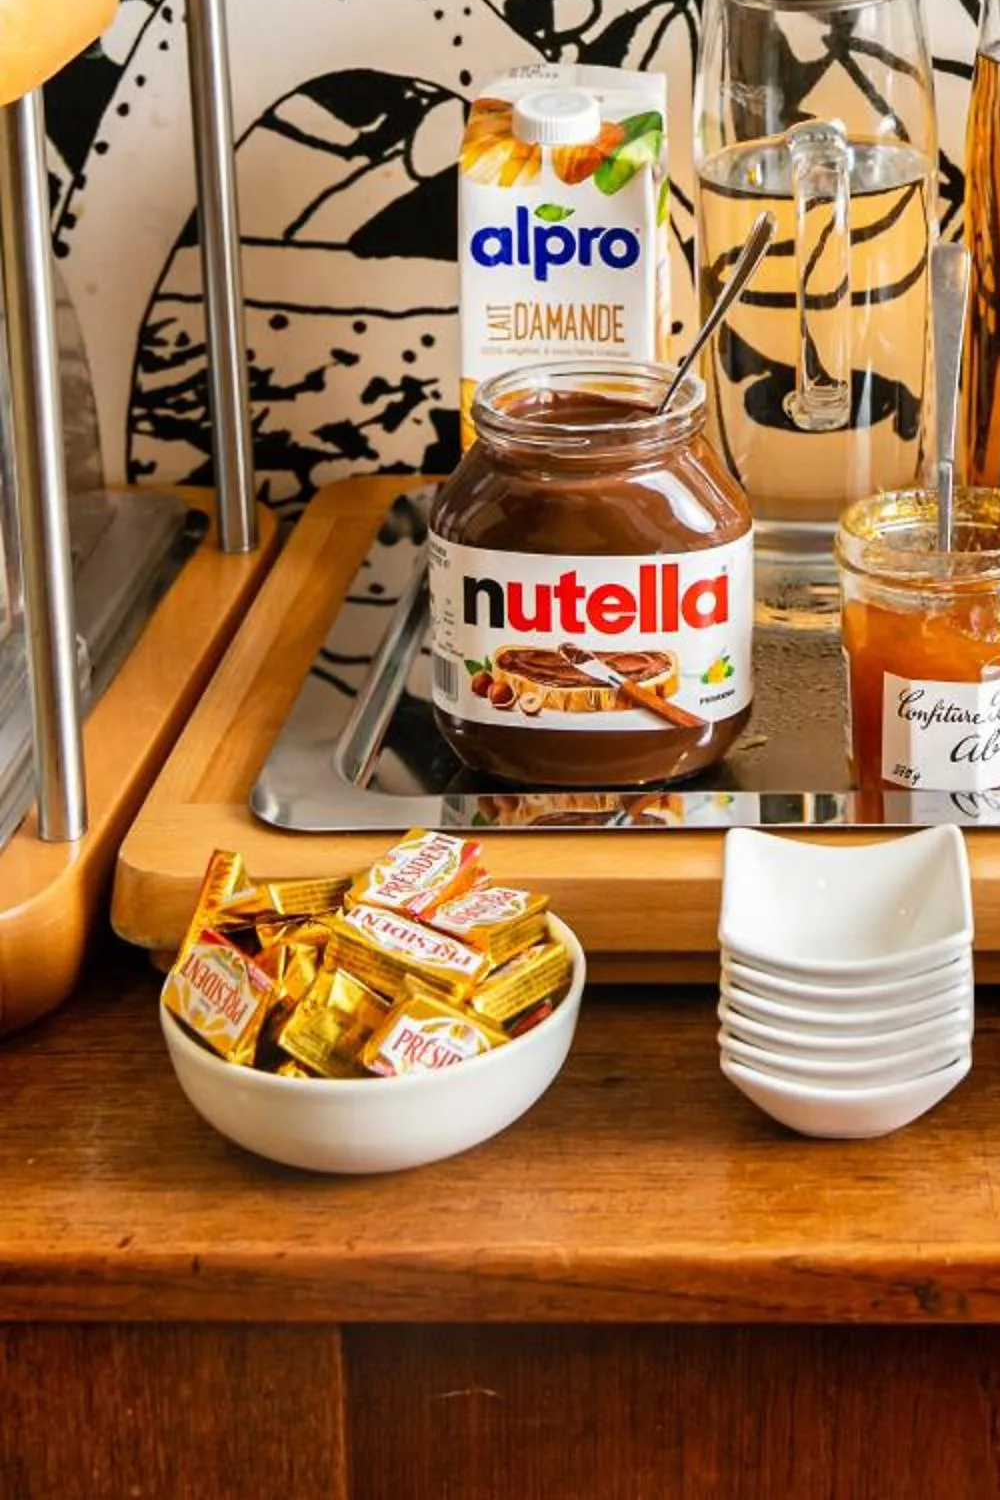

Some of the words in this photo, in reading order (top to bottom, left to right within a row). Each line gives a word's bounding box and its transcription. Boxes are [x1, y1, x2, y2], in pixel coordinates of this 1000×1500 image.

[470, 205, 641, 282] alpro
[486, 304, 512, 341] LAIT
[463, 563, 729, 635] nutella
[897, 688, 986, 731] Confiture
